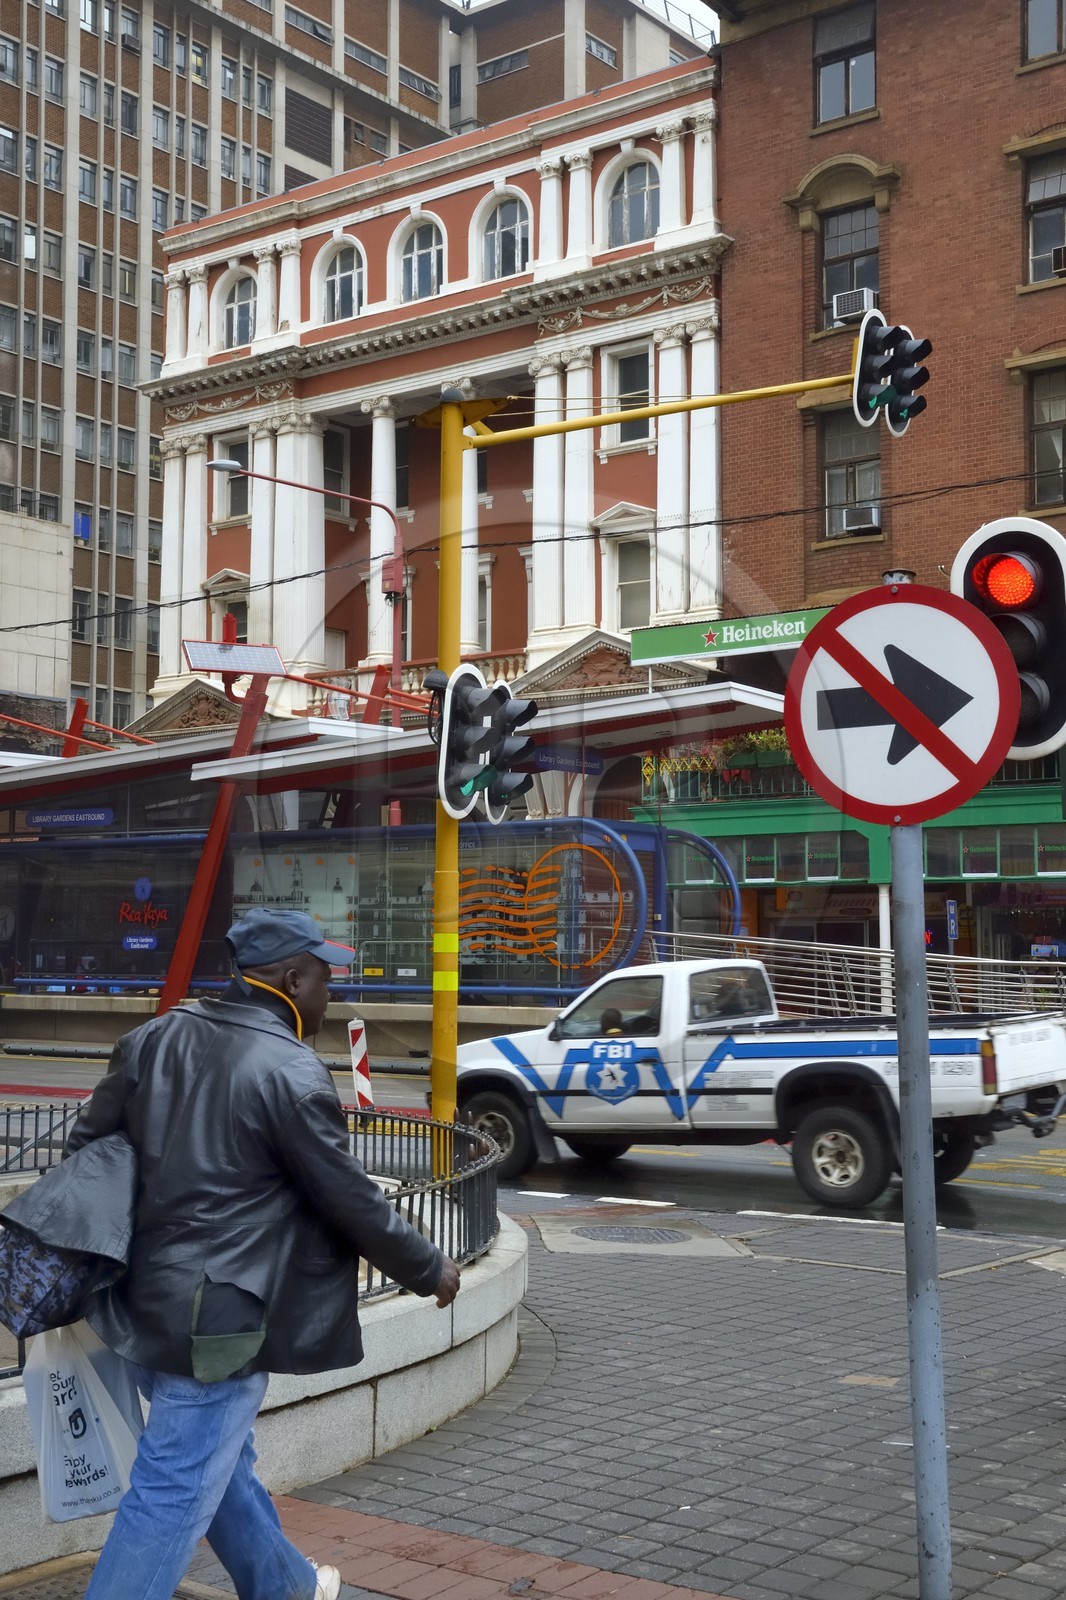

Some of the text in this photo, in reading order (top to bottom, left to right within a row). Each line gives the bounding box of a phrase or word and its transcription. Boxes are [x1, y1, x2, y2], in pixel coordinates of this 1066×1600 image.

[539, 753, 555, 765] Library
[576, 758, 600, 769] Eabound
[32, 813, 105, 823] LIBRARY GARDENS EASTBOUND
[119, 901, 168, 928] Rea Vaya
[593, 1045, 632, 1058] FBI
[49, 1371, 62, 1383] et
[52, 1376, 72, 1392] our
